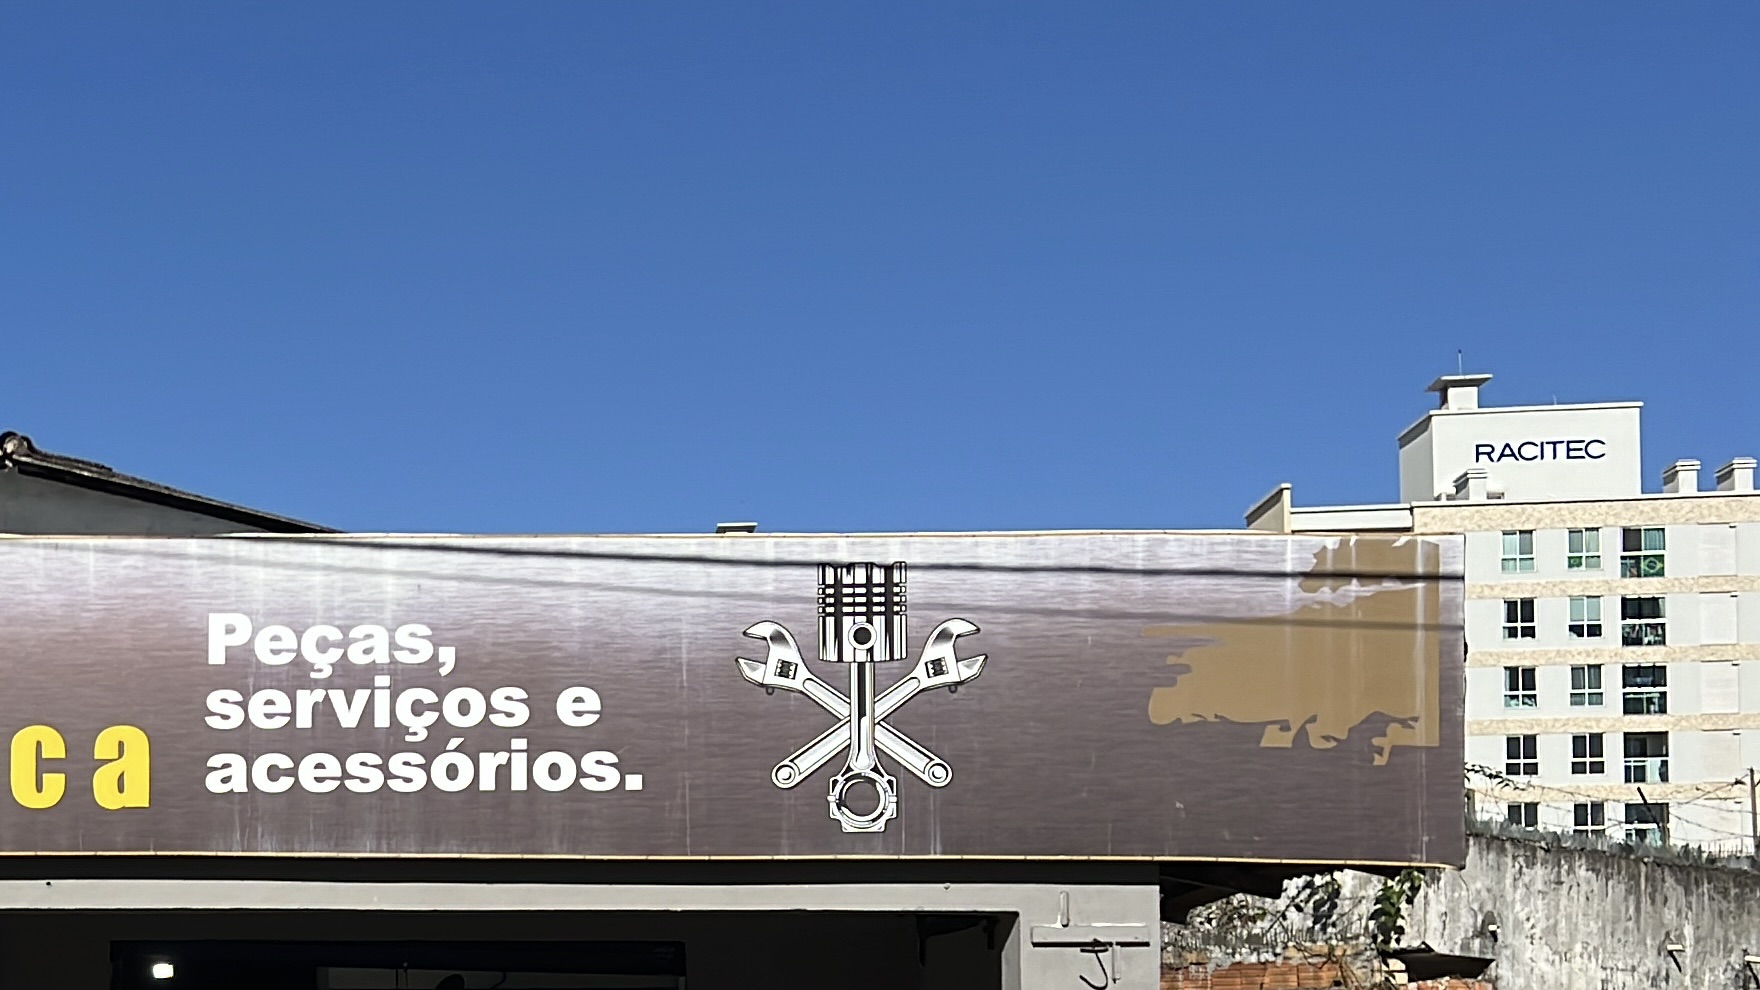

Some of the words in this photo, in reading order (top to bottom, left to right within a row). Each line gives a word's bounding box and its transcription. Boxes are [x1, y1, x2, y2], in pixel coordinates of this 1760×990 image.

[1474, 438, 1607, 464] RACITEC
[206, 612, 457, 679] Peças,
[204, 675, 531, 742] serviços
[555, 685, 603, 728] e
[204, 736, 644, 794] acessórios.
